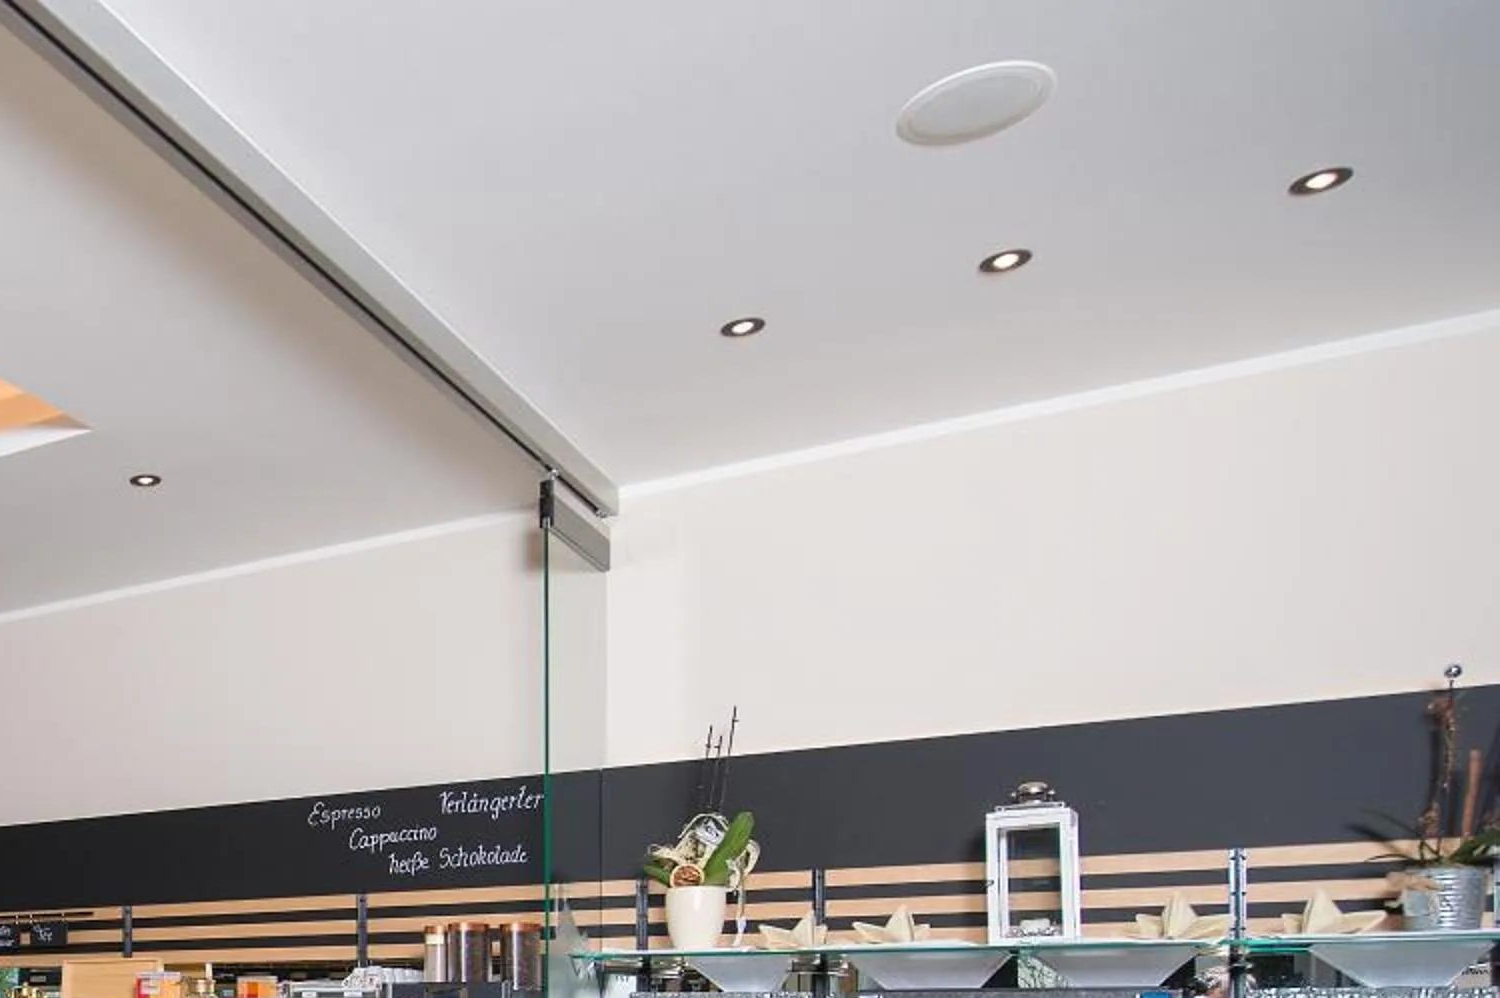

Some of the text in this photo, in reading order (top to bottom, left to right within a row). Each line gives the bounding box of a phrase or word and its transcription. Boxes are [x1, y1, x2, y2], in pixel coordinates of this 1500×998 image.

[308, 801, 381, 830] Espresso
[440, 785, 544, 820] Verlängerter
[349, 827, 437, 853] Cappuccino
[388, 844, 528, 876] heiße Schokolade
